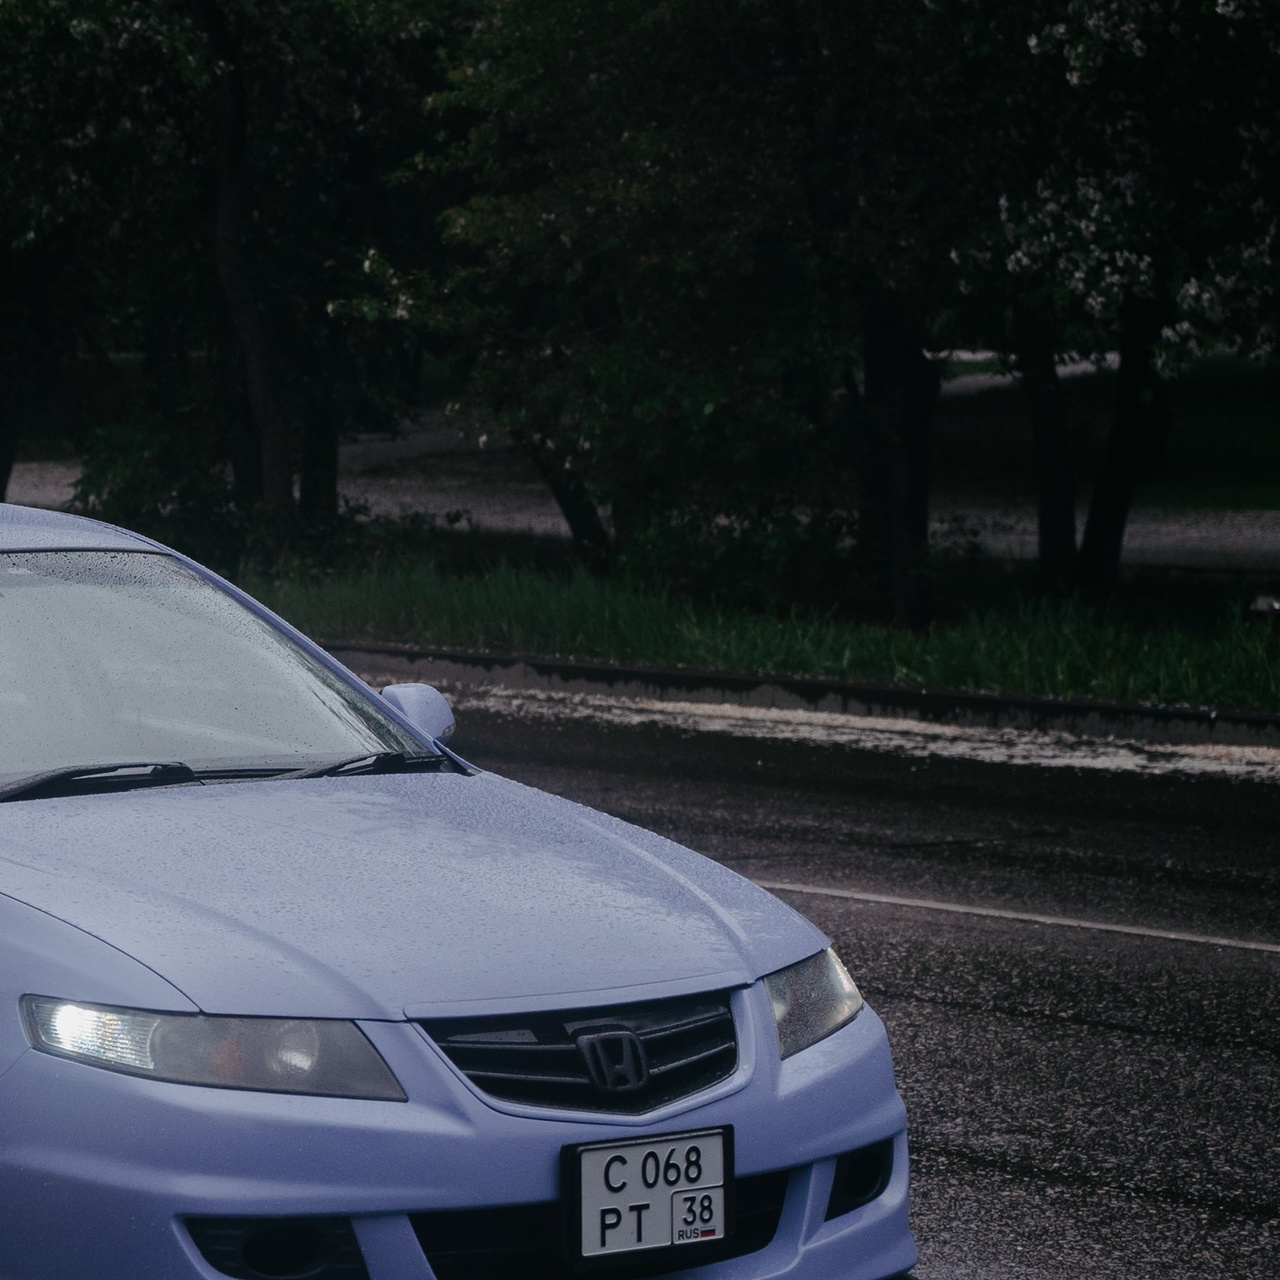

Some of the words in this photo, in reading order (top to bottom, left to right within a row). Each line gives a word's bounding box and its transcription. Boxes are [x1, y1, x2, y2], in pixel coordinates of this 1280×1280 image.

[640, 1144, 703, 1189] 068
[682, 1194, 714, 1226] 38
[677, 1227, 700, 1240] RUS
